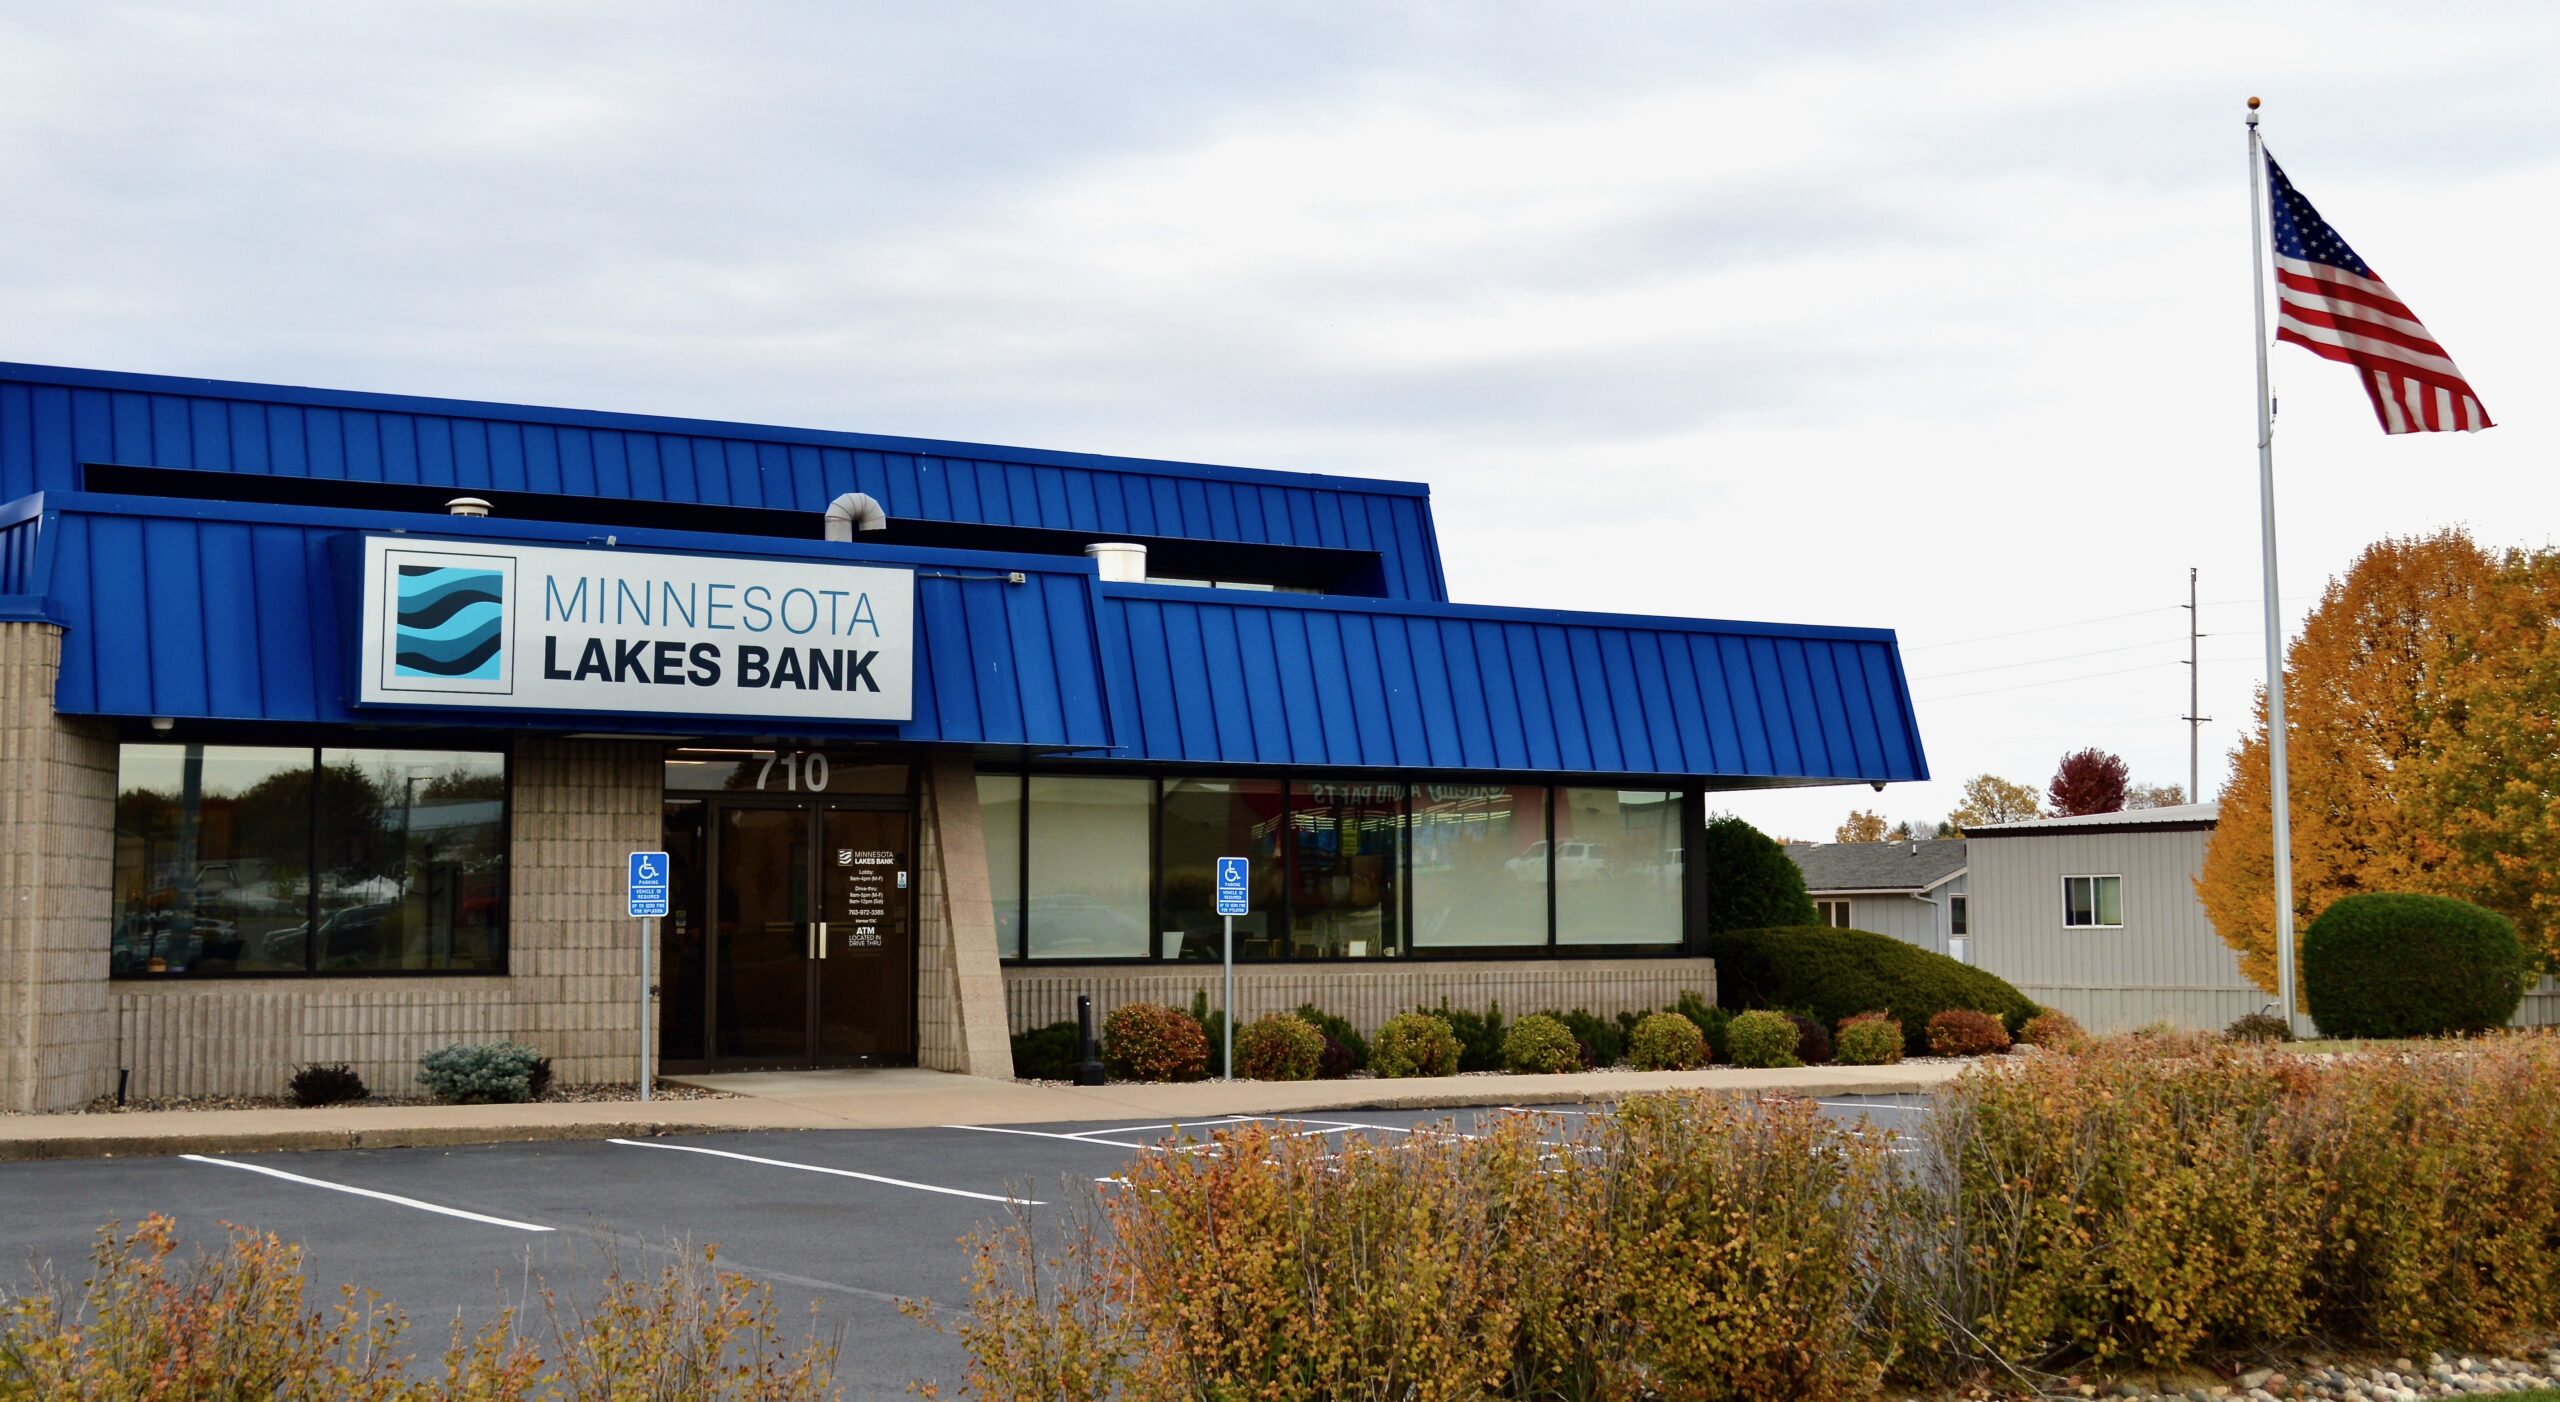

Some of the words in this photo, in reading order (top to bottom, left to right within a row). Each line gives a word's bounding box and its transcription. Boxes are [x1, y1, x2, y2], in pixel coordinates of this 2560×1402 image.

[545, 574, 880, 638] MINNESOTA
[544, 635, 721, 687] LAKES
[737, 644, 881, 693] BANK
[752, 752, 829, 792] 710
[856, 926, 875, 935] ATM
